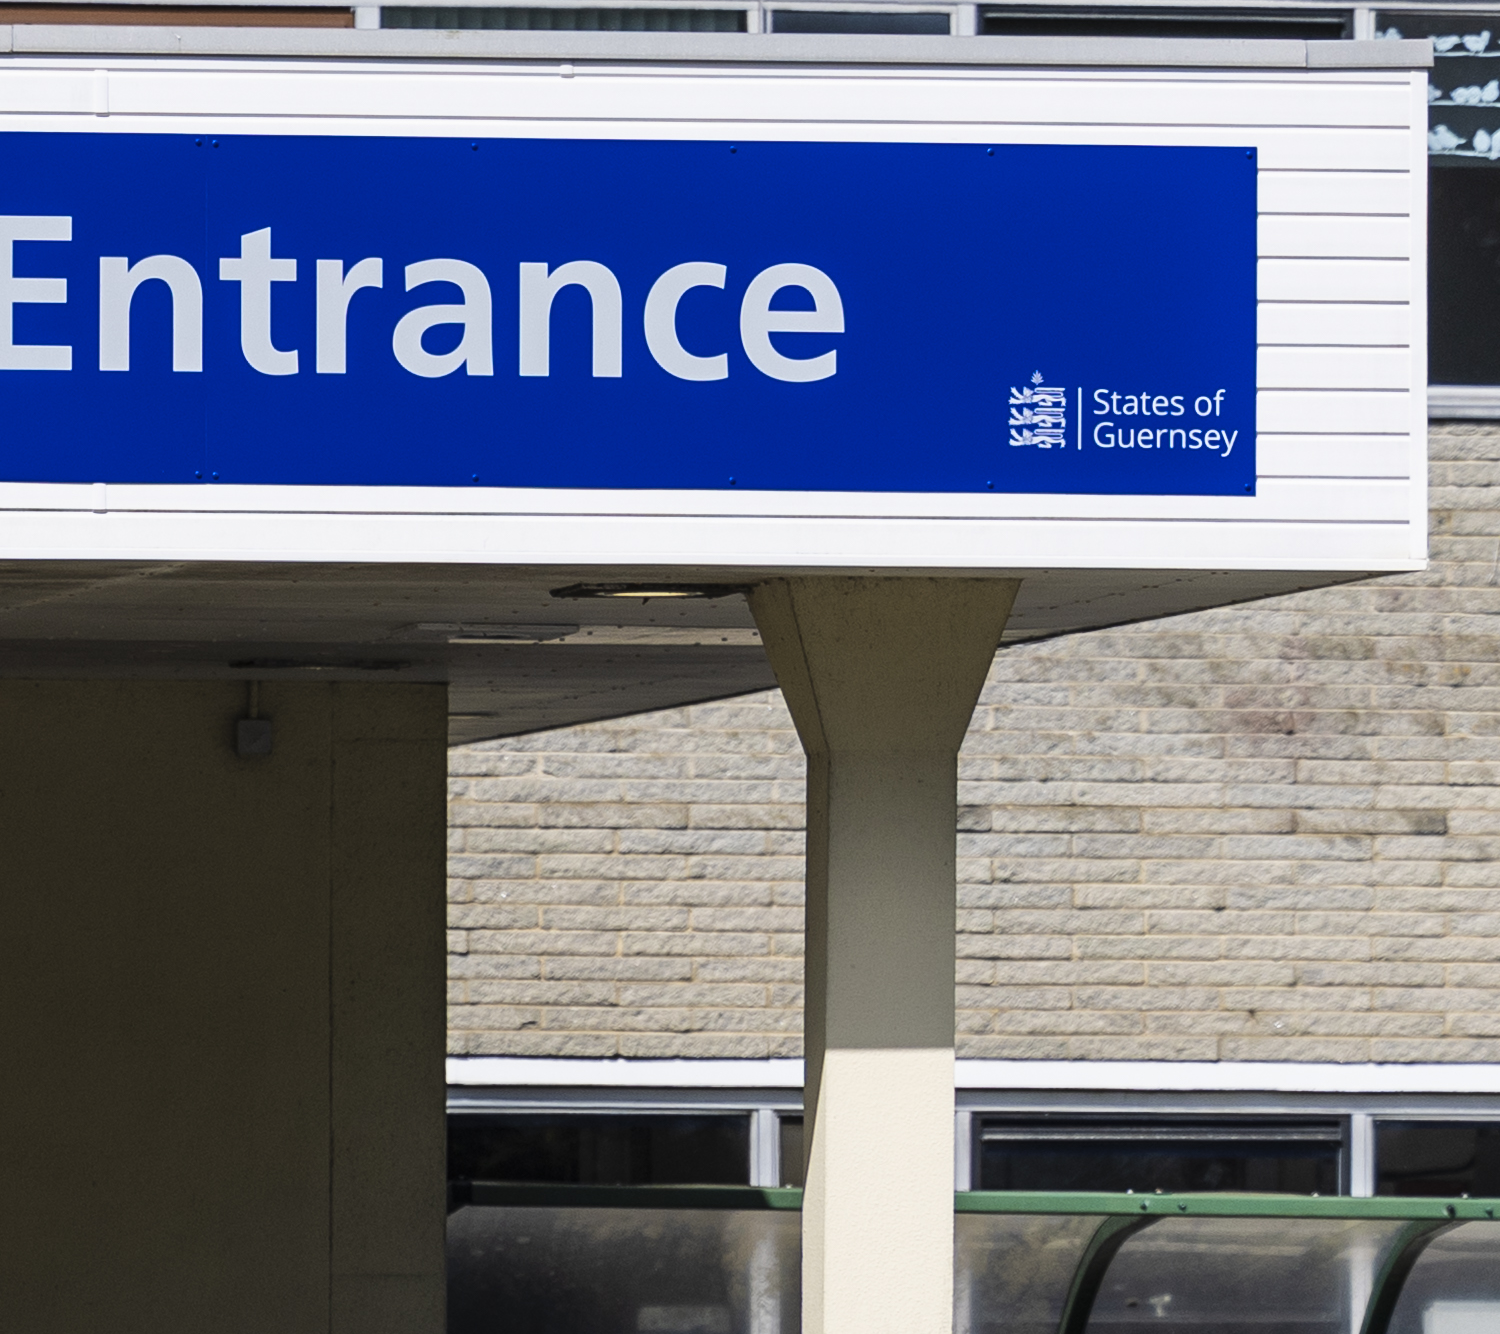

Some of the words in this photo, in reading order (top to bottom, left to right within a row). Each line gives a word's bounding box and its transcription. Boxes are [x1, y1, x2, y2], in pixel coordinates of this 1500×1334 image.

[1094, 389, 1185, 417] States
[1195, 389, 1227, 417] of
[1093, 422, 1239, 458] Guernsey
